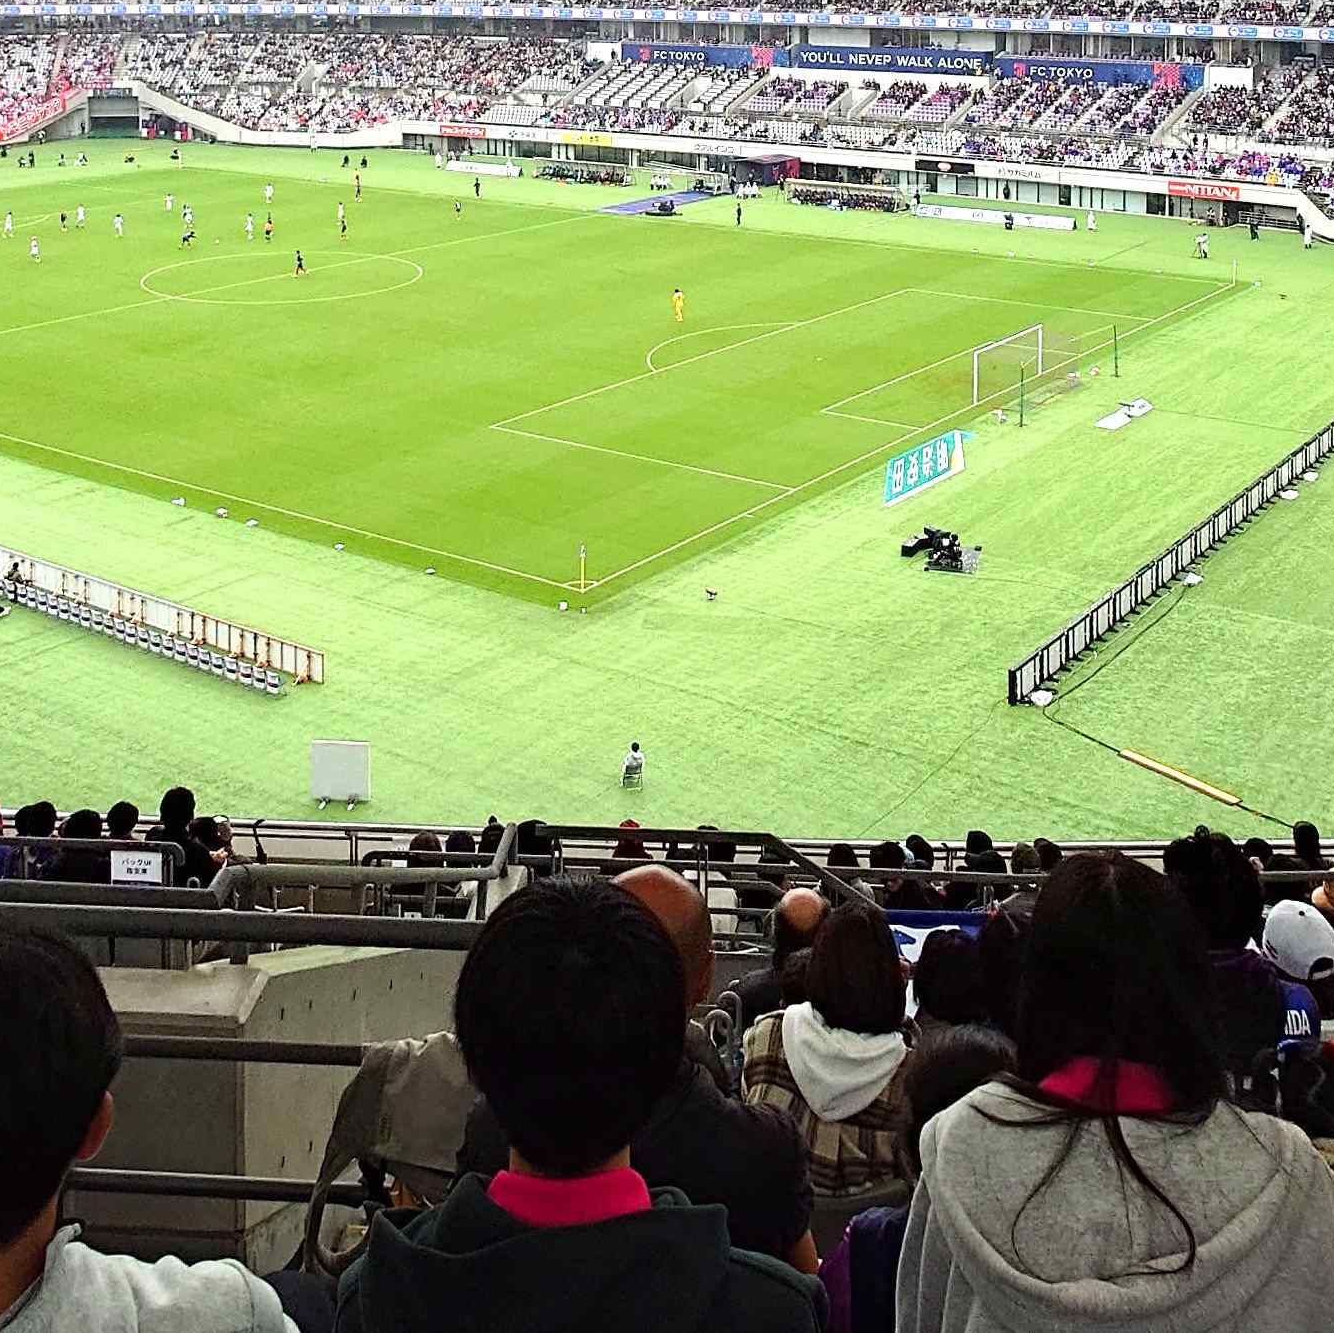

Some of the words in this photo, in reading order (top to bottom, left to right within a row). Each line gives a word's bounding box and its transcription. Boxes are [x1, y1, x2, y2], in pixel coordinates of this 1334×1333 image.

[654, 50, 667, 60] FC
[668, 51, 705, 61] TOKYO
[800, 51, 844, 64] YOU'LL
[849, 54, 893, 66] NEVER
[896, 55, 934, 68] WALK
[937, 57, 982, 68] ALONE
[1029, 66, 1046, 77] FC
[1048, 67, 1093, 79] TOKYO
